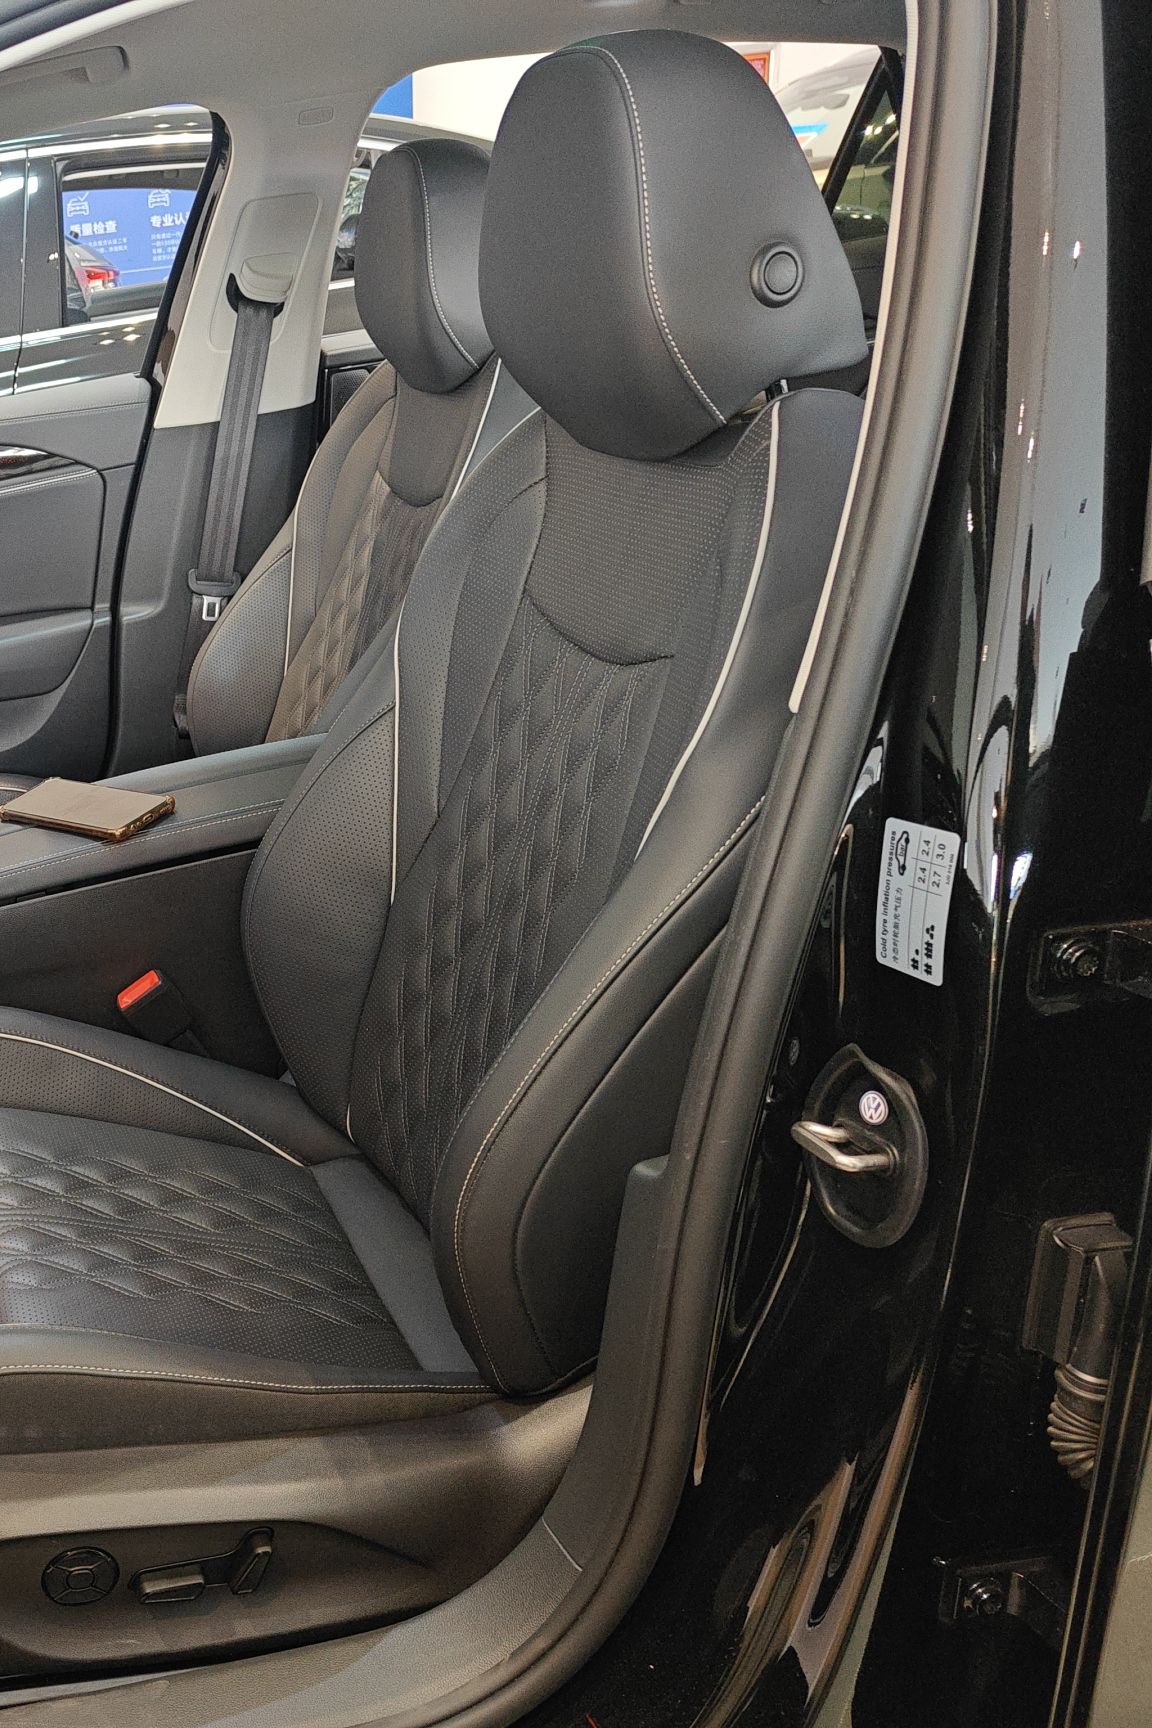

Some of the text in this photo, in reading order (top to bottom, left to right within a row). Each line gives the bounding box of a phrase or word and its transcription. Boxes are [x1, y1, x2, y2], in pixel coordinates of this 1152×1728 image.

[882, 879, 890, 915] inflation
[887, 831, 896, 877] pressures
[918, 839, 930, 885] 2.4 2.4
[932, 843, 946, 889] 2.7 3.0
